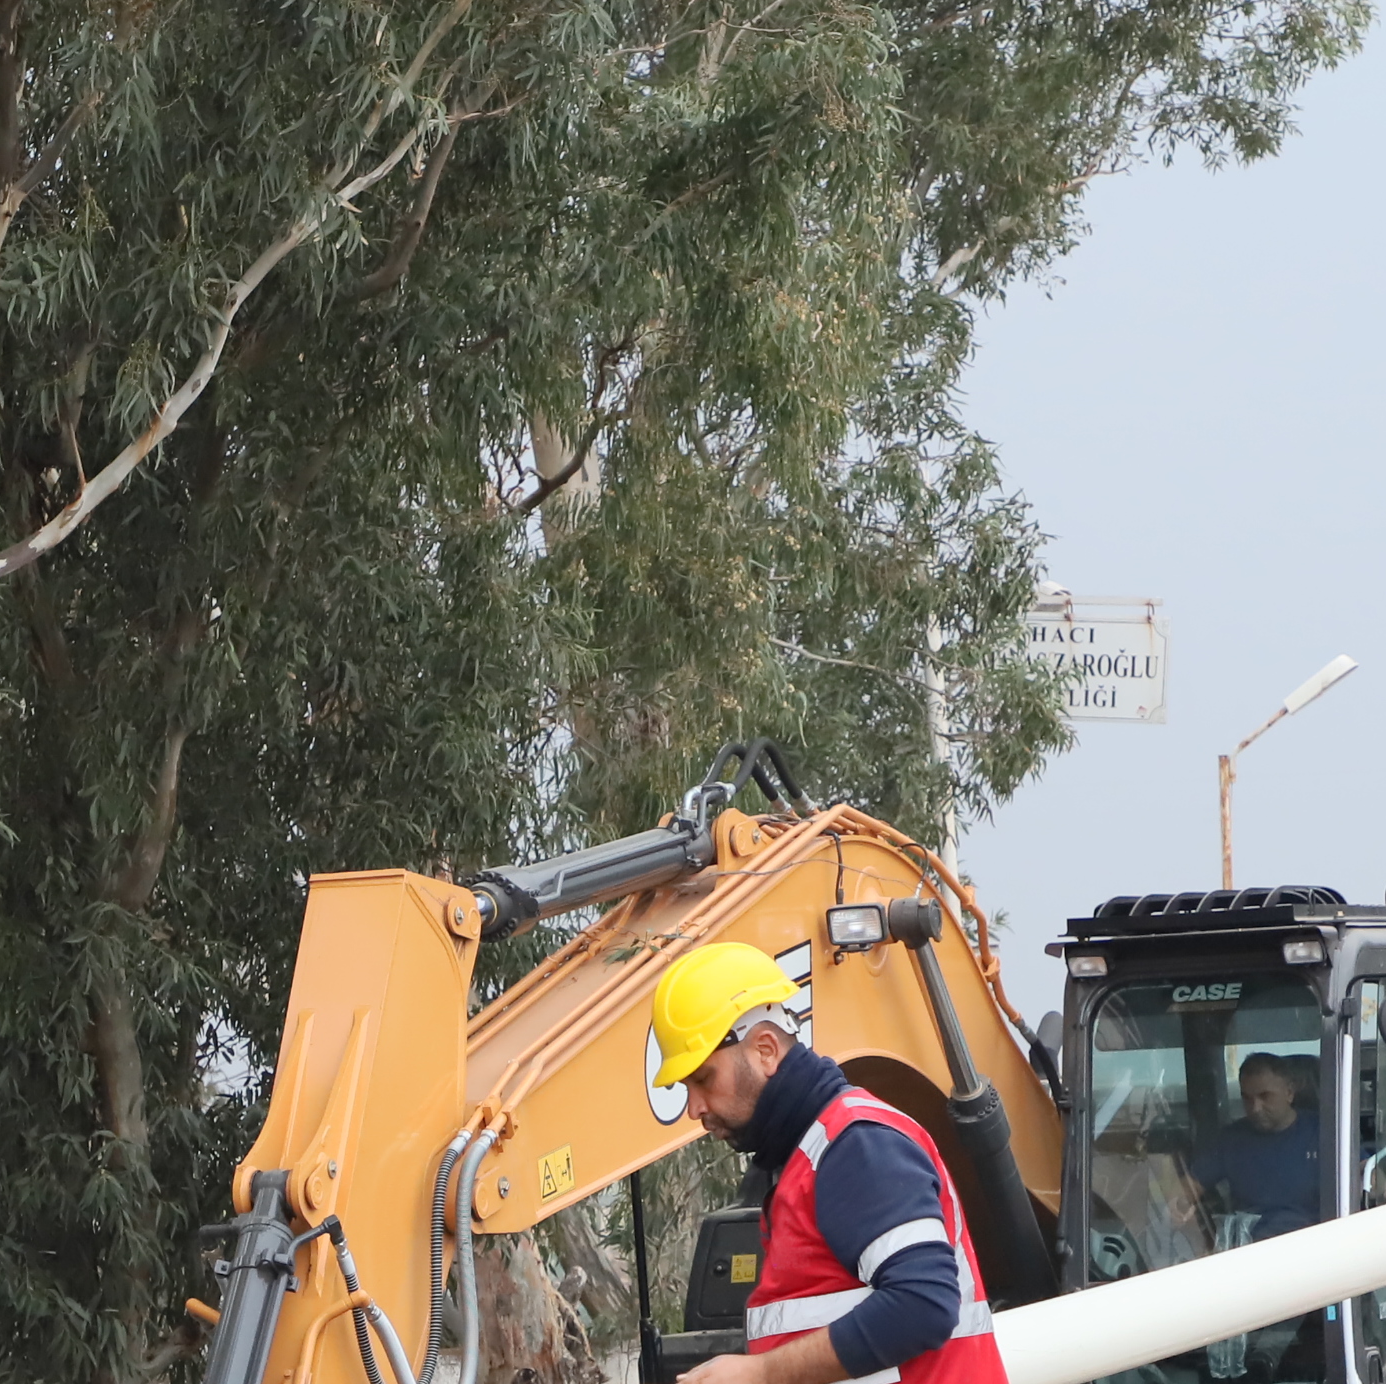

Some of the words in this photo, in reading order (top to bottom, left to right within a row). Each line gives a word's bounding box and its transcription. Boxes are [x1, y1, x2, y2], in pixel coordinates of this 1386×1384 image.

[1033, 626, 1095, 643] HACI
[1068, 684, 1117, 708] LİĞİ
[1172, 983, 1242, 1002] CASE
